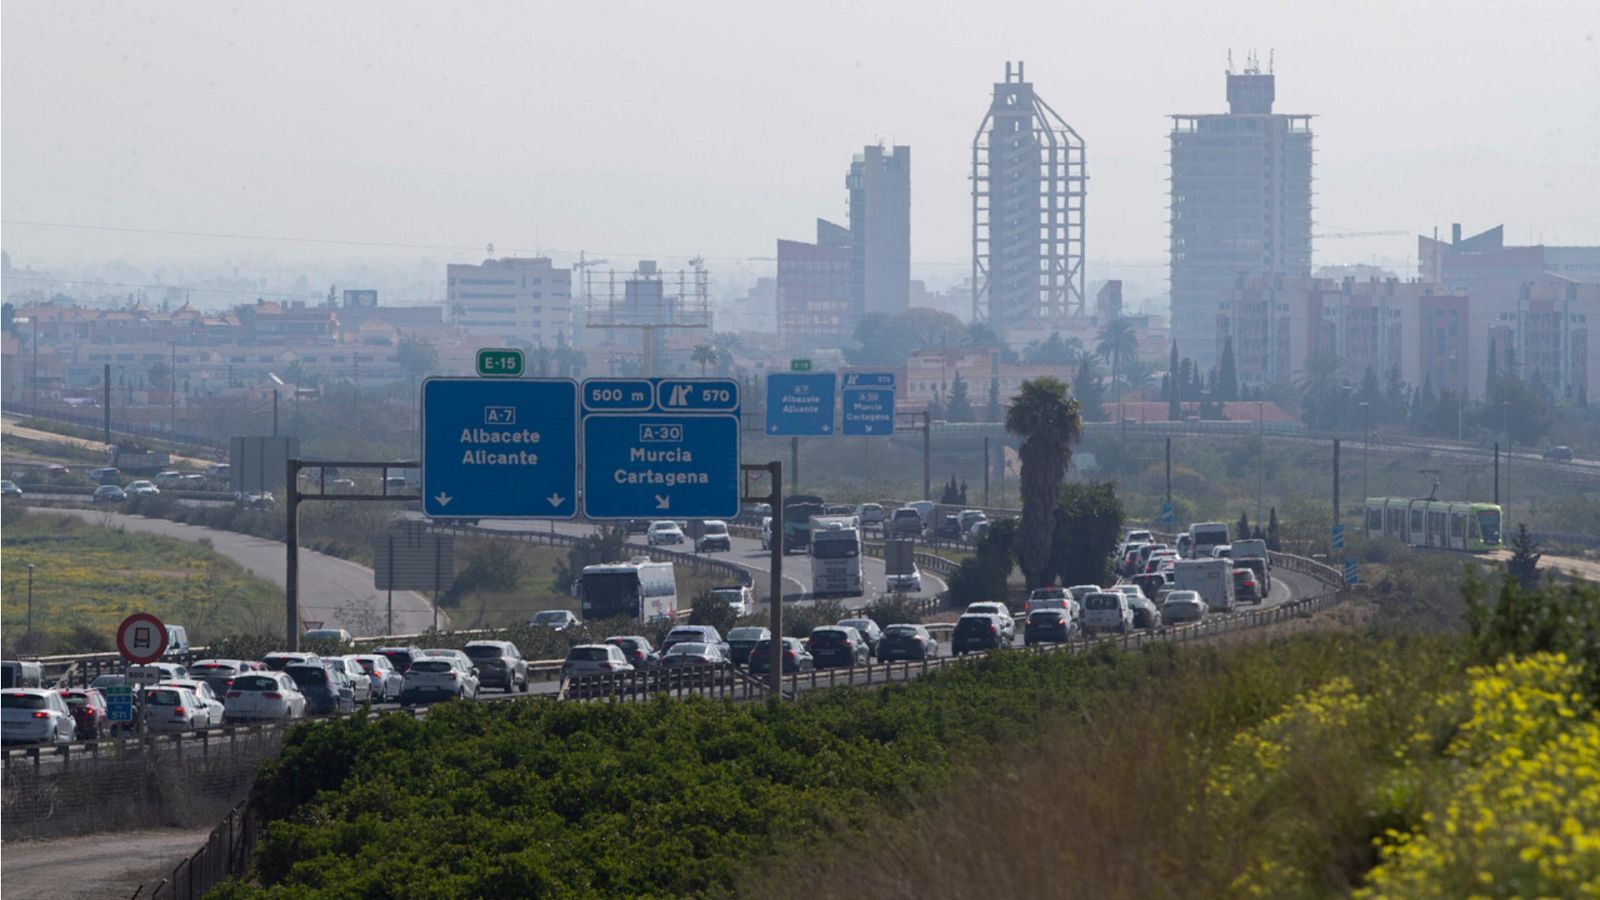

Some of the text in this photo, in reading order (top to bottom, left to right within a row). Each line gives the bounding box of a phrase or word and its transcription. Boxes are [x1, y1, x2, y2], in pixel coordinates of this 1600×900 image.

[485, 358, 516, 369] E-15
[592, 390, 644, 401] 500 m
[702, 390, 730, 401] 570
[782, 395, 819, 403] Albacete
[783, 405, 818, 413] Alicante
[854, 403, 882, 411] Murcia
[488, 410, 512, 422] A-7
[846, 413, 890, 422] Cartagena
[460, 429, 540, 444] Albacete
[642, 427, 680, 439] A-30
[462, 450, 538, 465] Alicante
[630, 448, 692, 462] Murcia
[614, 469, 708, 486] Cartagena
